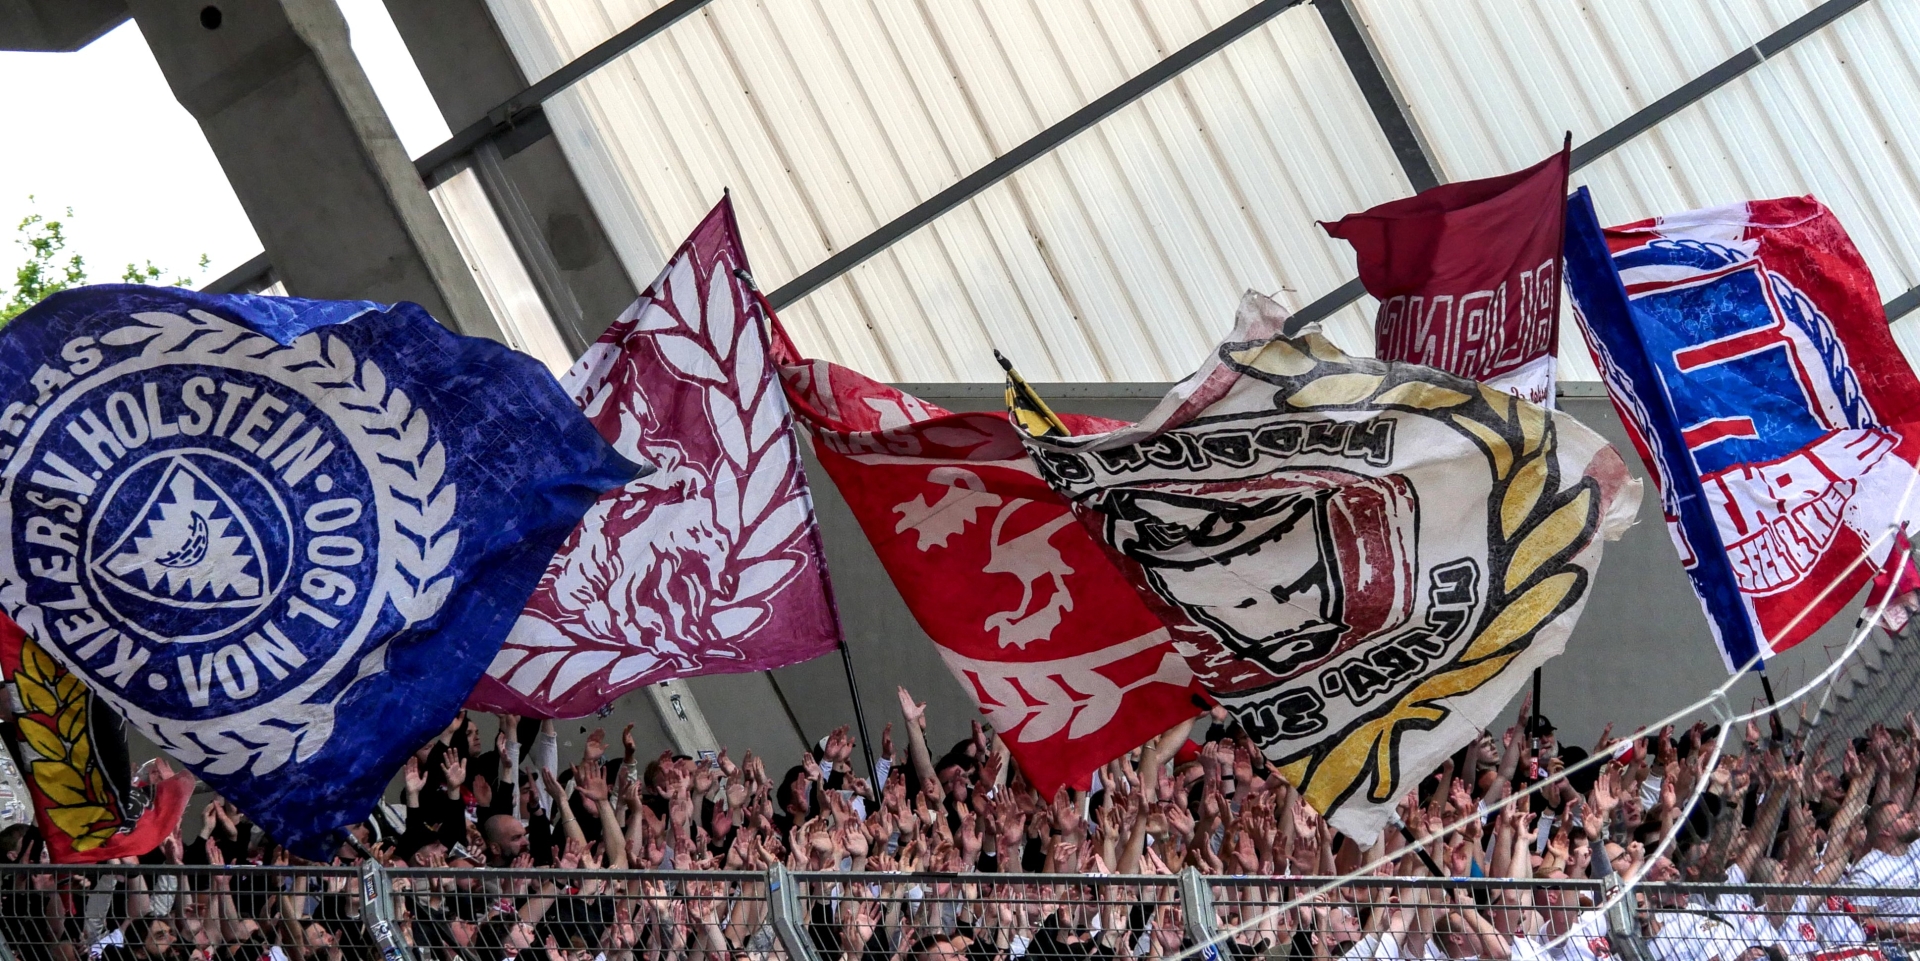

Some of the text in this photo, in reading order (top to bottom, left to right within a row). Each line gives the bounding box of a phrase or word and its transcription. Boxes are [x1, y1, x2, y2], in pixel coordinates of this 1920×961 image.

[66, 376, 335, 489] HOLSTEIN
[25, 514, 151, 690] KIELER
[177, 496, 363, 708] VON 1900
[1726, 529, 1797, 590] SSEL
